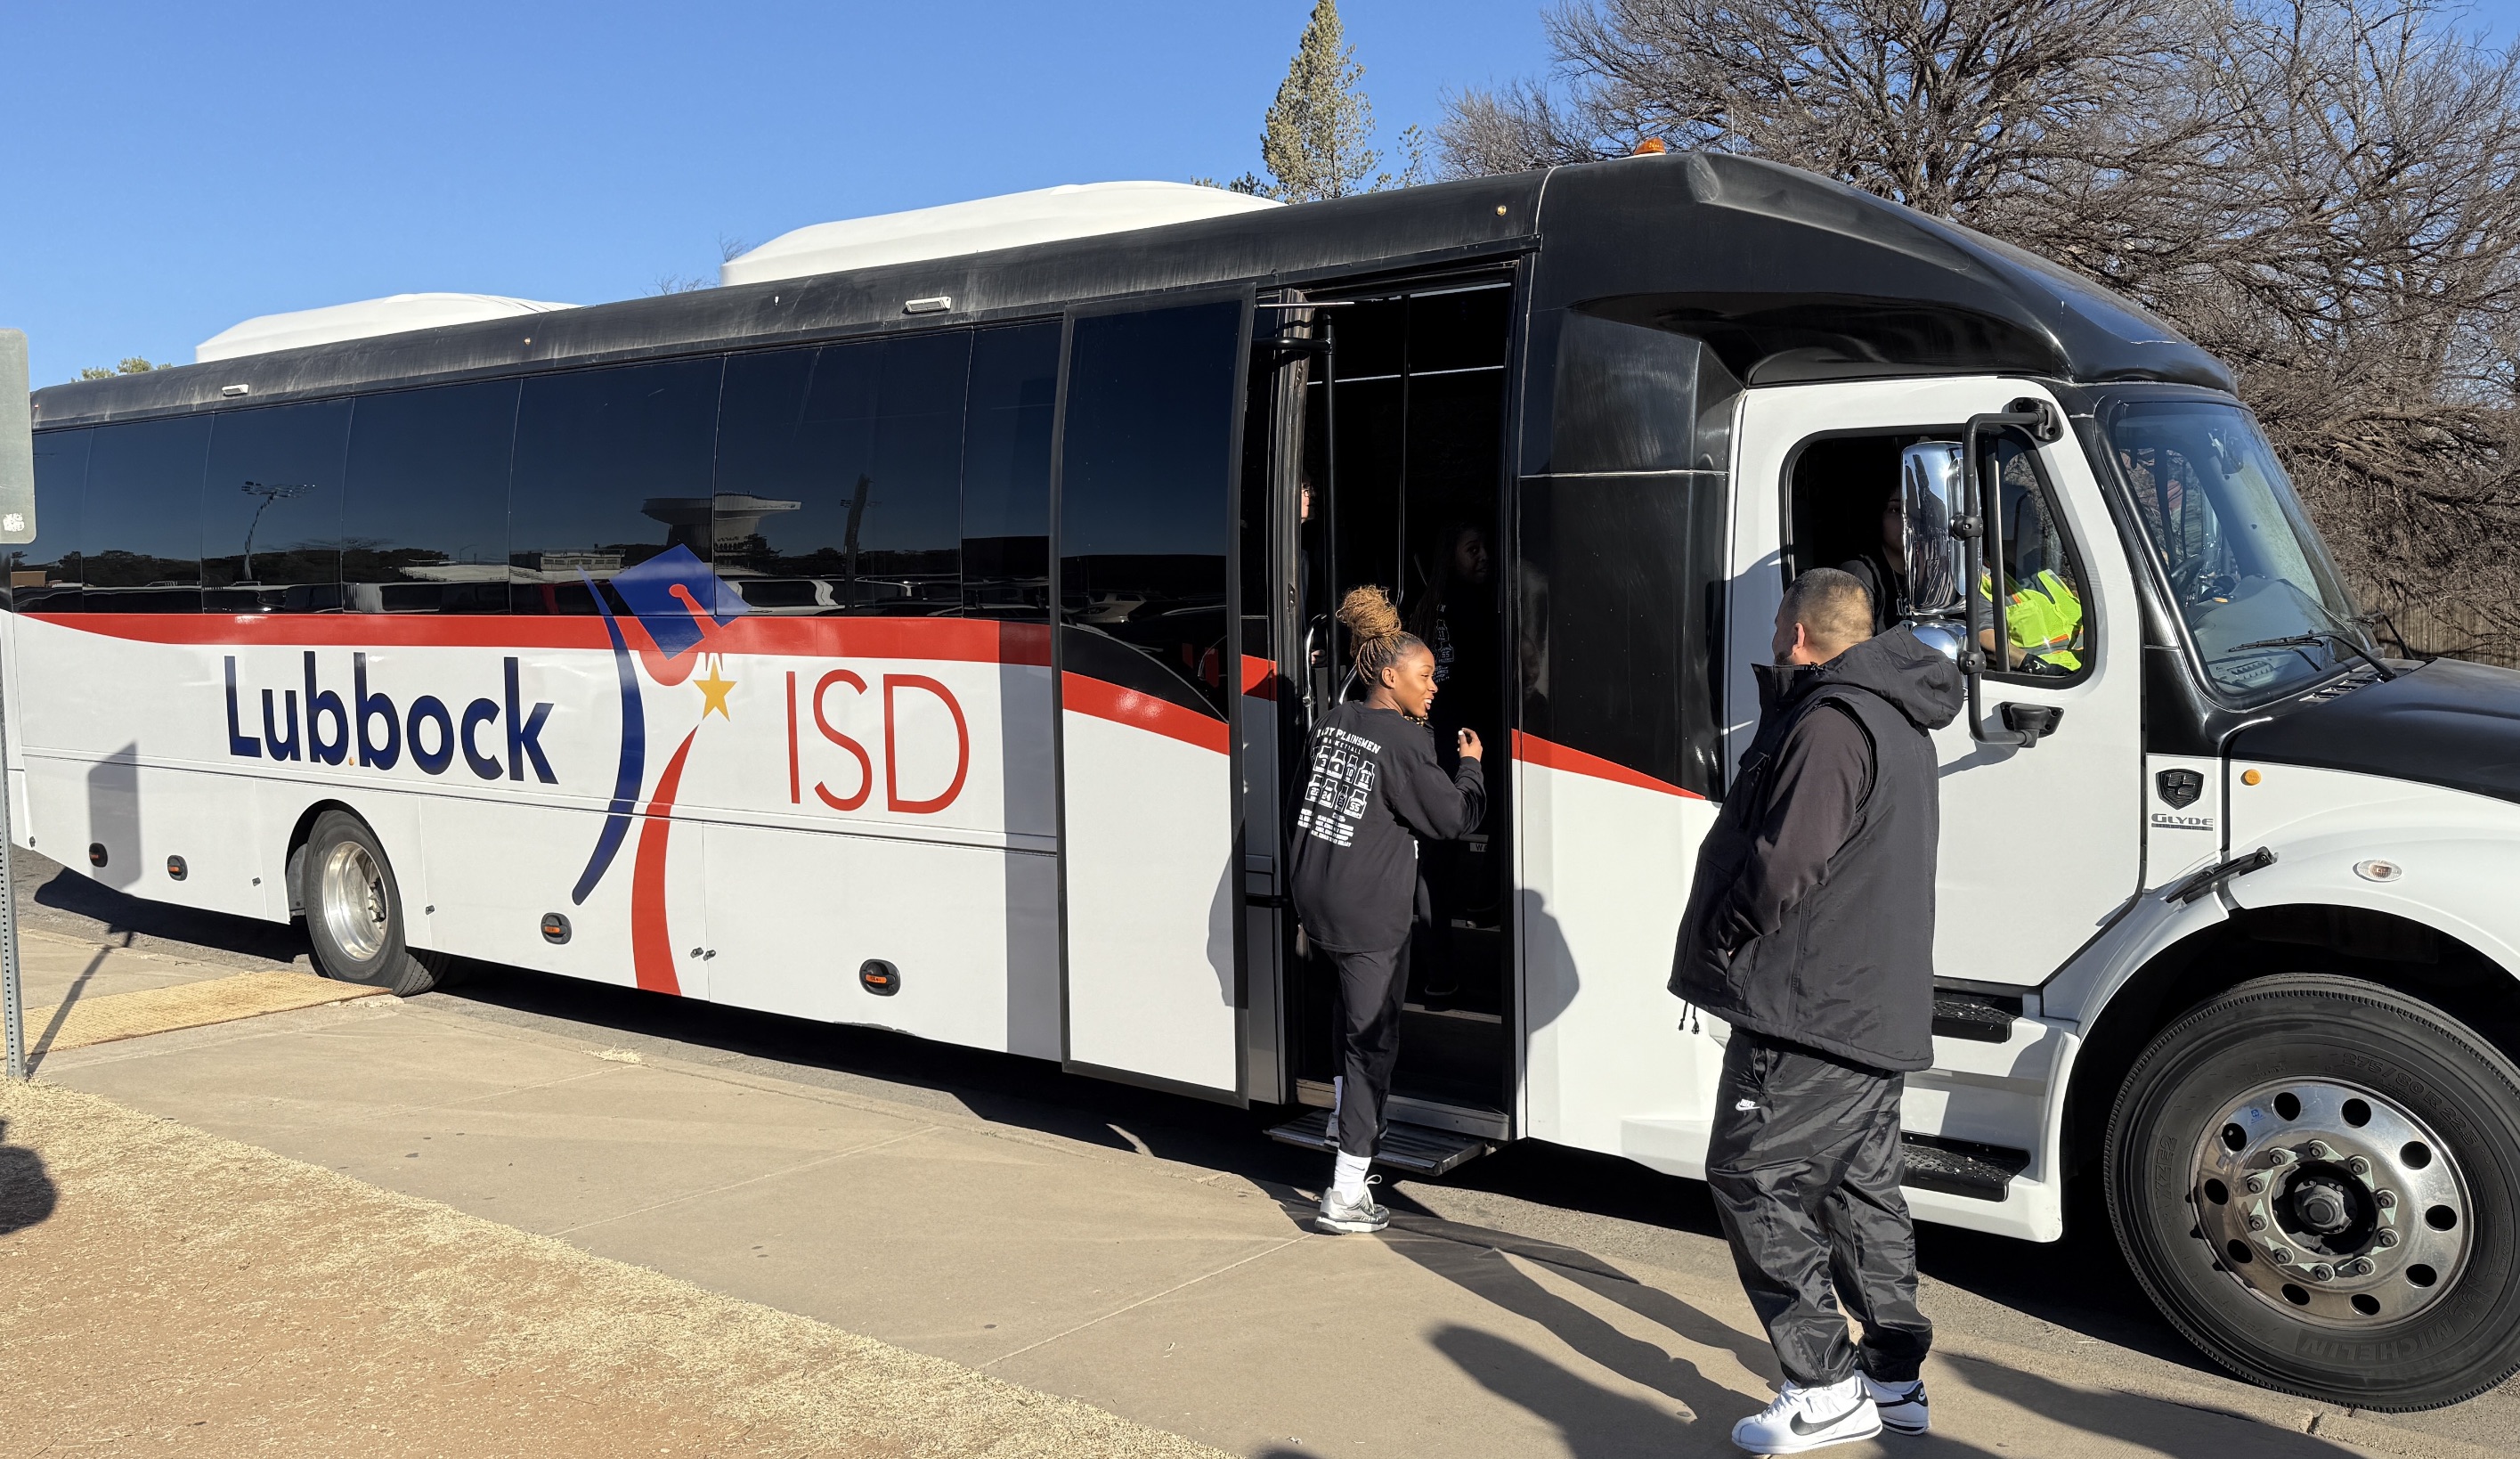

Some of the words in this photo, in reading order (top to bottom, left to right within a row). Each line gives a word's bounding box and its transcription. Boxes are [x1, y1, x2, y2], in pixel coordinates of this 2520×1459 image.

[224, 651, 559, 785] Lubbock
[785, 668, 971, 814] ISD
[1336, 729, 1382, 754] PLAINSMEN
[1359, 772, 1370, 784] 11
[2150, 812, 2214, 827] GLYDE
[2299, 1316, 2457, 1362] MICHELIN
